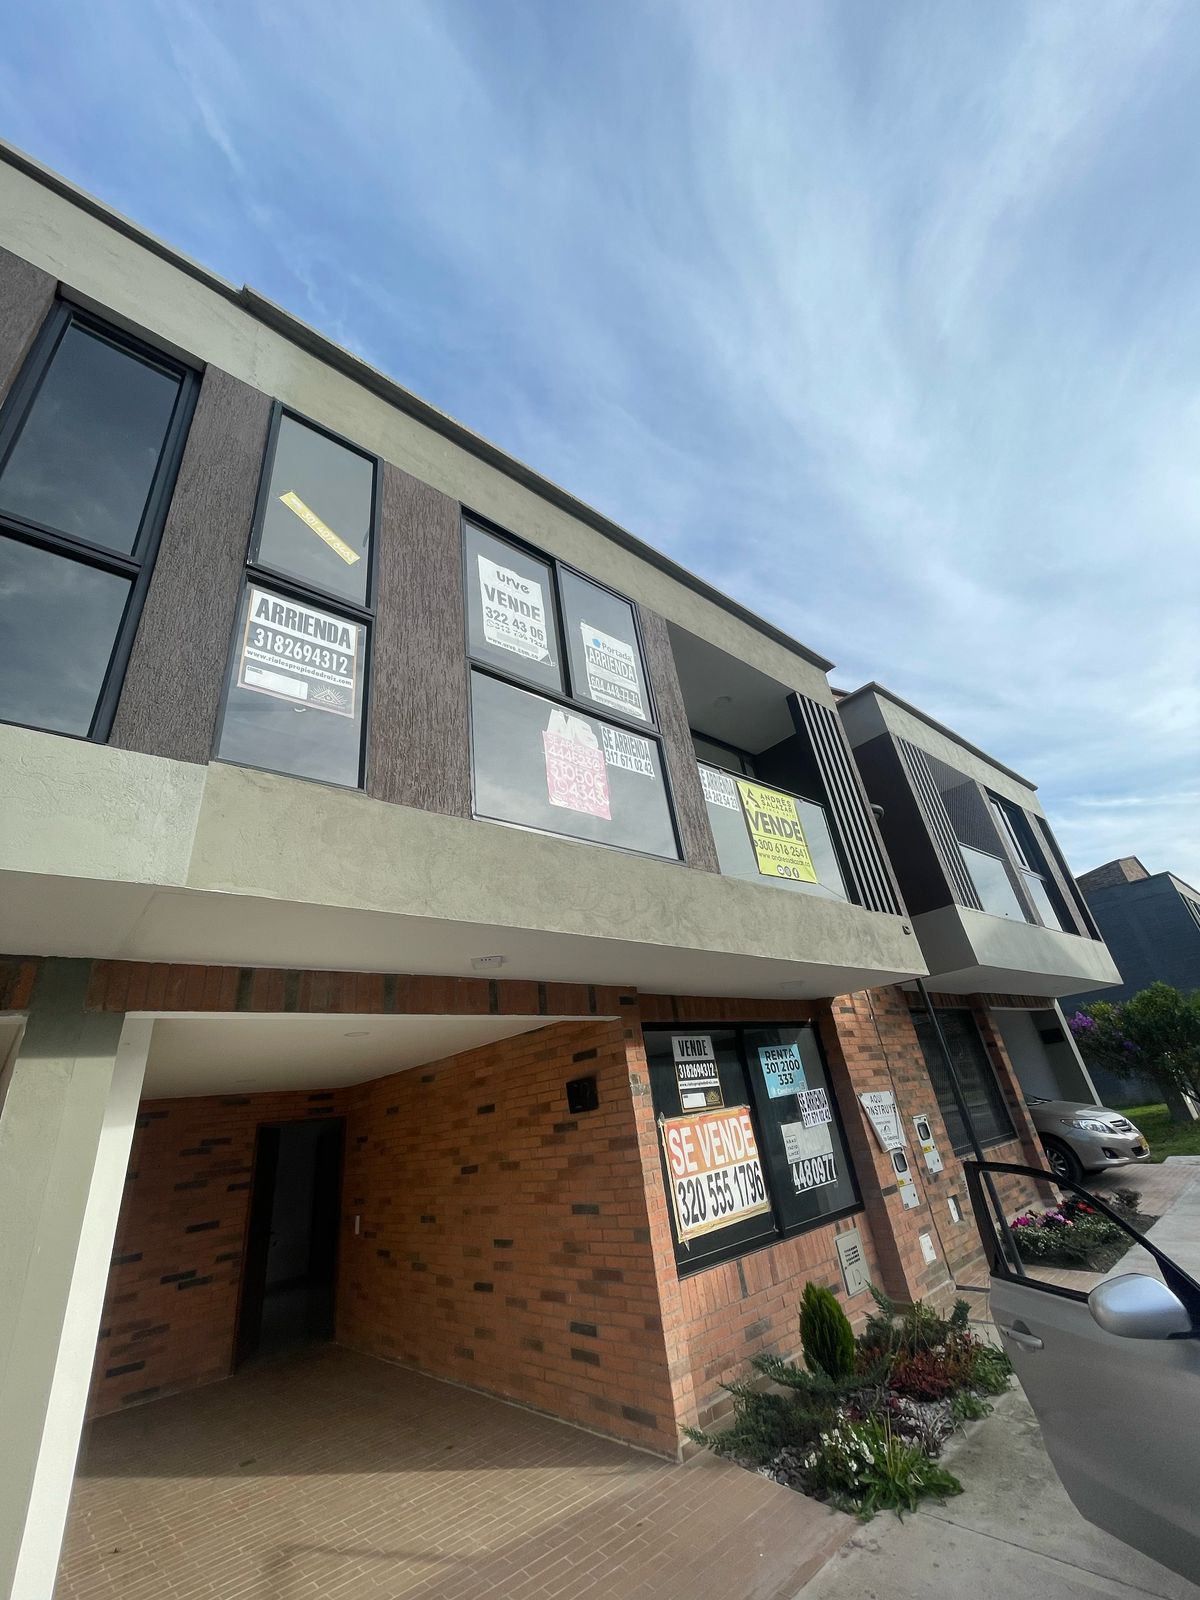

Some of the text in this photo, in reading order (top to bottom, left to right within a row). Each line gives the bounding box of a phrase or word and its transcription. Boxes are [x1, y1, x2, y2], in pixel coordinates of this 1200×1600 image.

[484, 584, 541, 622] VENDE
[256, 598, 351, 650] ARRIENDA
[486, 606, 544, 642] 322 43 06
[254, 628, 348, 674] 3182694312
[589, 648, 635, 681] ARRIENDA
[602, 642, 632, 662] Portada
[602, 728, 613, 751] SE
[614, 732, 652, 762] ARRIENDA
[606, 750, 618, 764] 317
[621, 754, 633, 768] 671
[761, 800, 793, 814] SALAZAR
[746, 808, 803, 842] VENDE
[758, 838, 808, 860] 300 618 2541
[678, 1039, 708, 1057] VENDE
[764, 1049, 795, 1062] RENTA
[678, 1062, 716, 1078] 3182694312
[778, 1072, 794, 1086] 333
[668, 1115, 756, 1176] SE VENDE
[793, 1152, 837, 1190] 4480977
[677, 1161, 764, 1227] 320 555 1796
